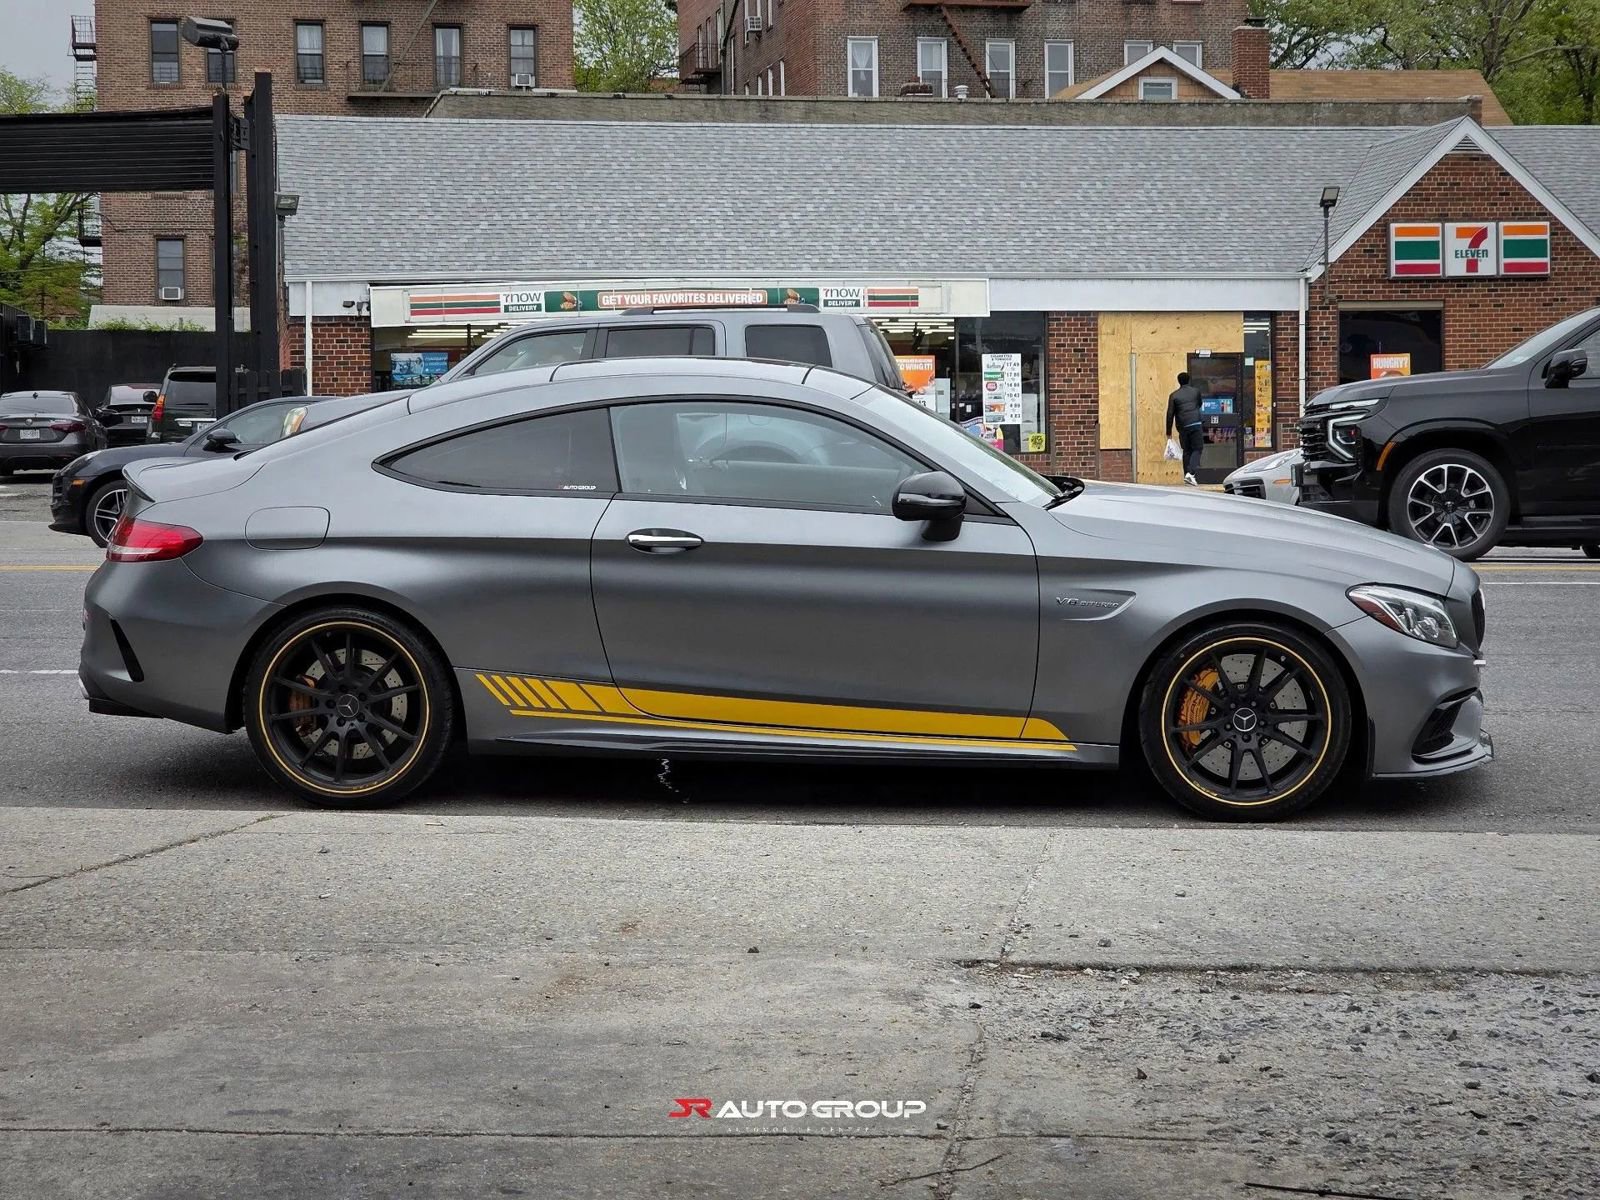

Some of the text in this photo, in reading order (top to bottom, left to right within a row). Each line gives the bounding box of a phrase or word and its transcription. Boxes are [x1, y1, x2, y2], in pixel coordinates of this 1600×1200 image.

[602, 292, 763, 305] GET YOUR FAVORITES DELIVERED
